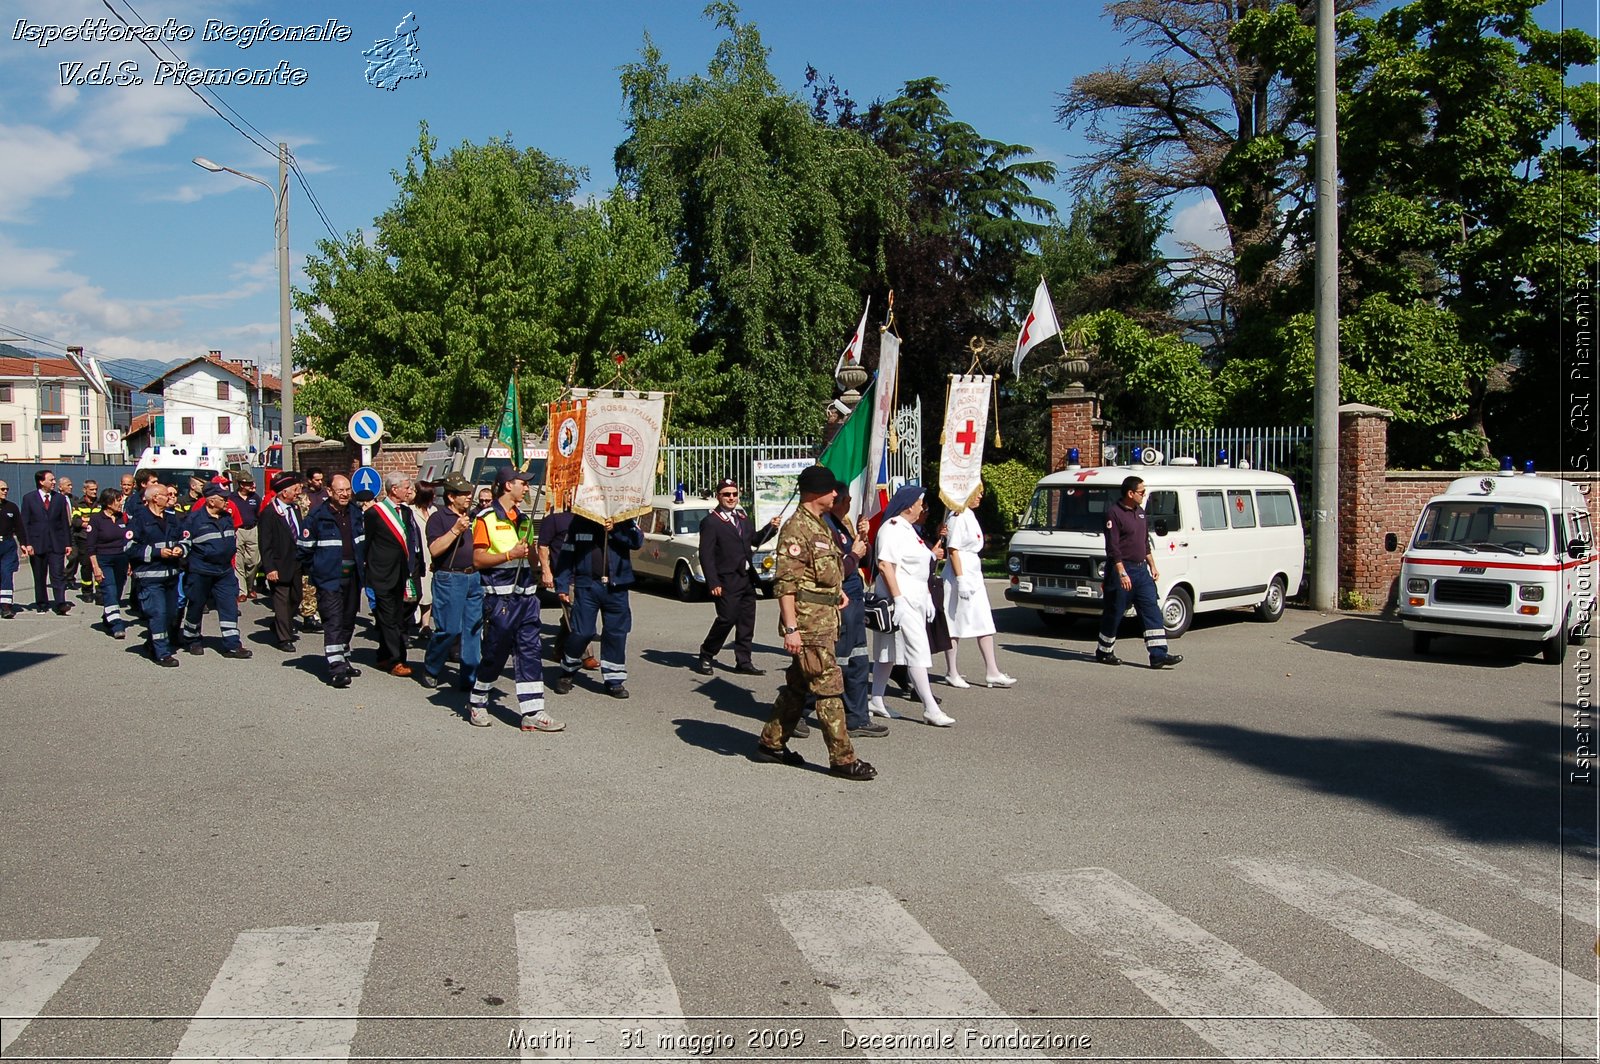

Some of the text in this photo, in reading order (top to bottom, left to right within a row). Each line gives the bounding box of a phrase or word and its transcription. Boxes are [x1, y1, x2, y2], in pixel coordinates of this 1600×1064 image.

[600, 404, 658, 432] ROSSA ITALIANA
[581, 485, 642, 494] COMITATO LOCALE
[609, 494, 646, 505] TORINESE
